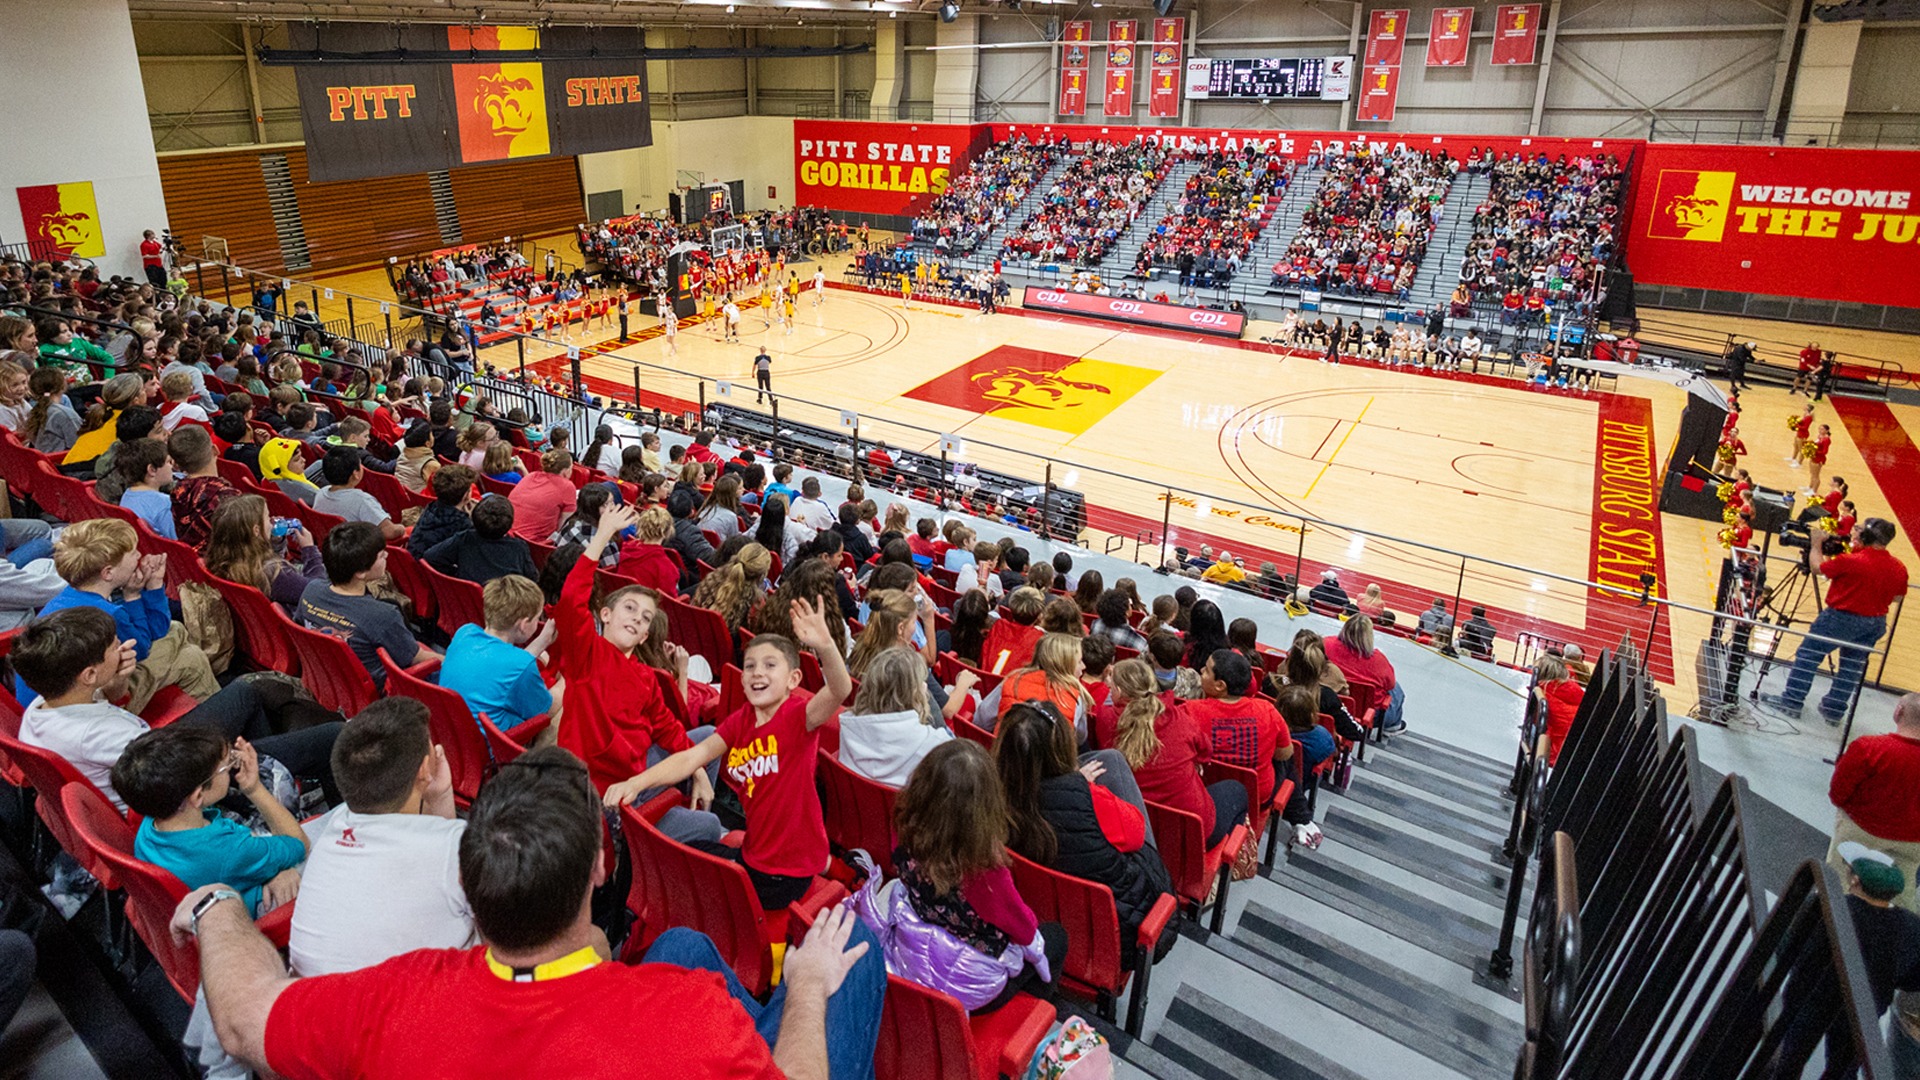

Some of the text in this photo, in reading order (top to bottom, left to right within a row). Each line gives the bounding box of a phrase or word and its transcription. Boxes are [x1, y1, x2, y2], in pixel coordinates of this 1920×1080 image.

[1188, 63, 1210, 71] CDL
[1259, 59, 1279, 68] 3:48
[566, 75, 642, 107] STATE
[1240, 75, 1249, 83] 18
[1287, 74, 1294, 83] 6
[326, 84, 416, 122] PITT
[800, 139, 951, 164] PITT STATE
[800, 160, 950, 194] GORILLAS
[1740, 184, 1911, 209] WELCOME
[1735, 206, 1920, 244] THE JU
[1036, 291, 1069, 304] CDL
[1109, 301, 1144, 314] CDL
[1189, 311, 1228, 326] CDL
[1600, 419, 1654, 521] PITTSBURG
[991, 648, 1012, 675] 1
